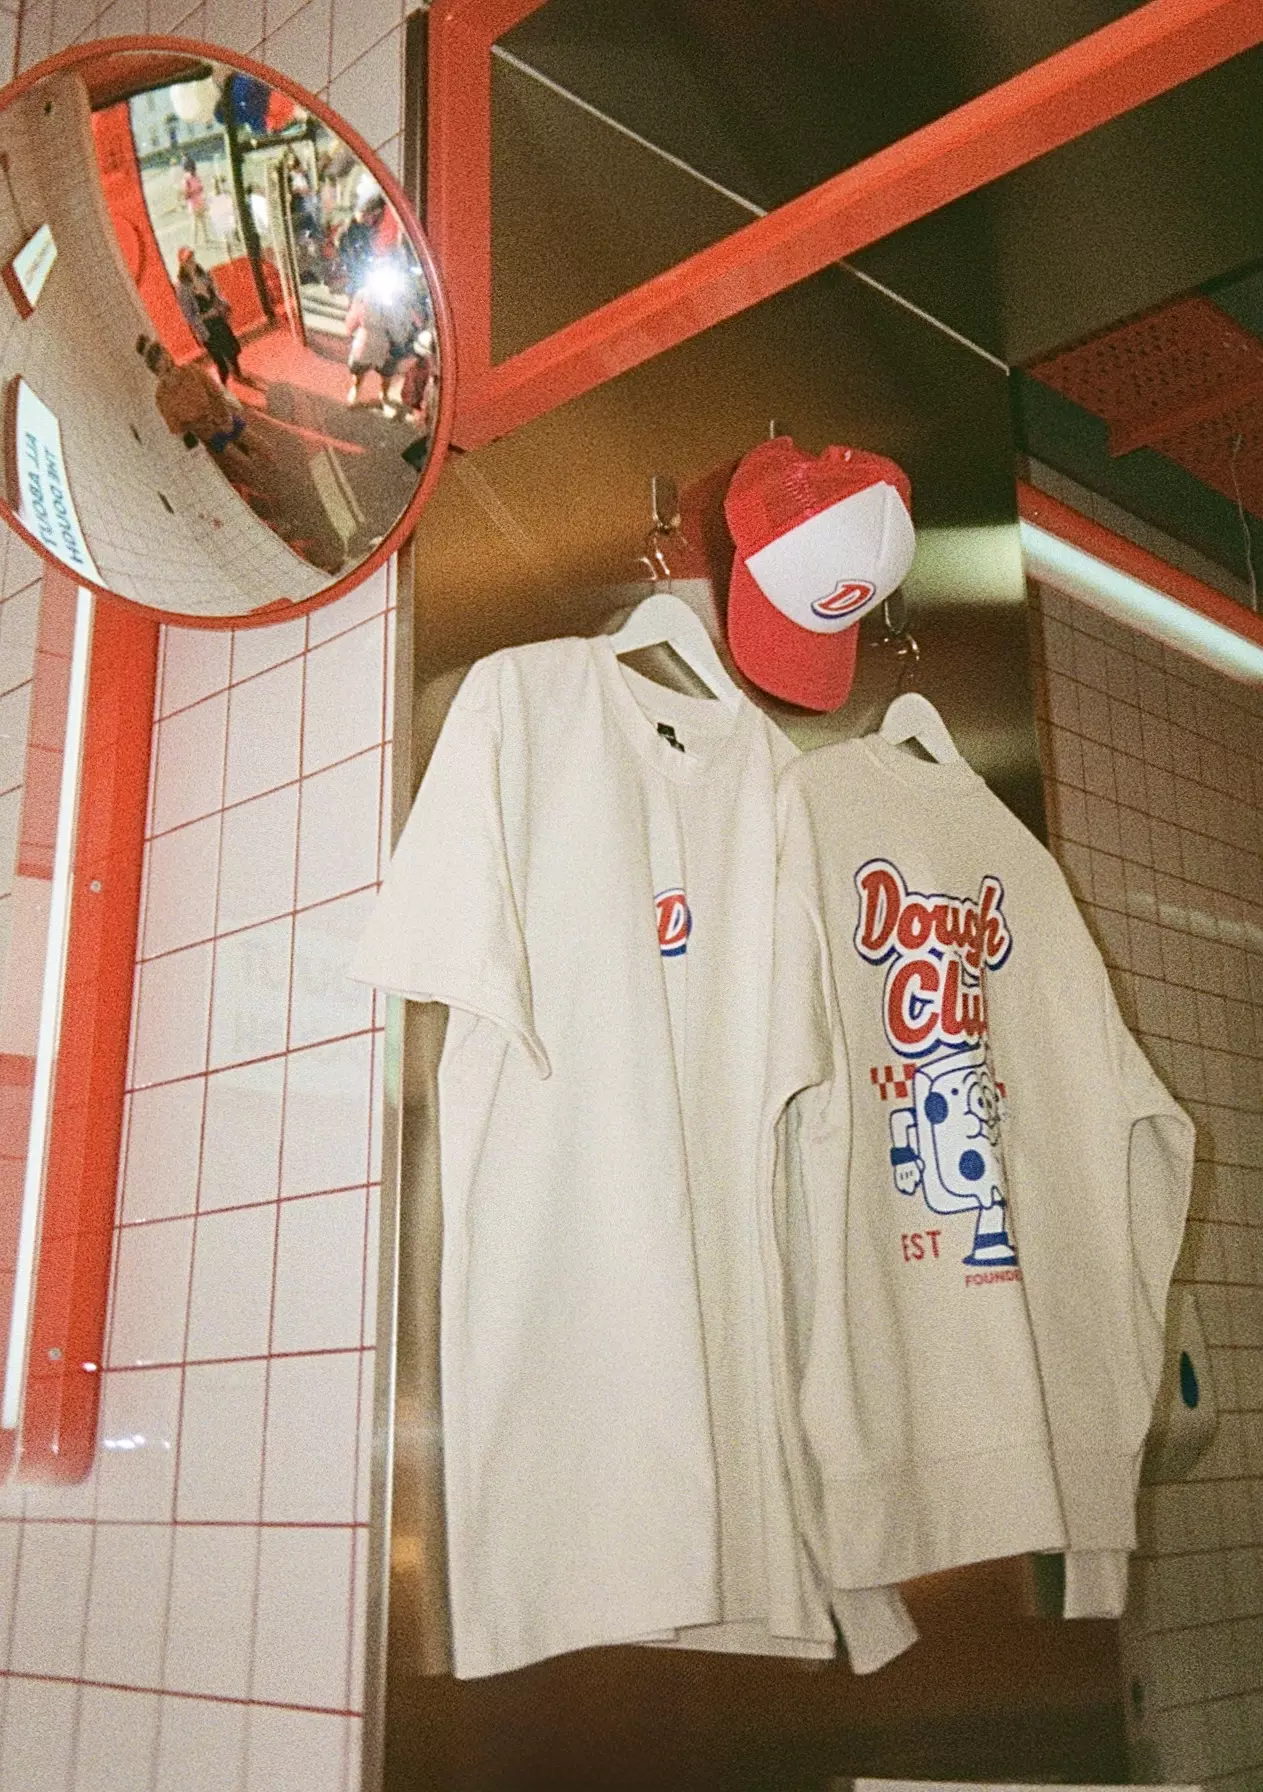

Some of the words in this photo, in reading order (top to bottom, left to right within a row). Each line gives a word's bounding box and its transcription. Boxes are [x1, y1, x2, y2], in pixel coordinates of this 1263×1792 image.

[814, 581, 874, 616] D
[655, 890, 690, 952] D
[857, 863, 1008, 969] Dough
[885, 957, 988, 1050] Clu
